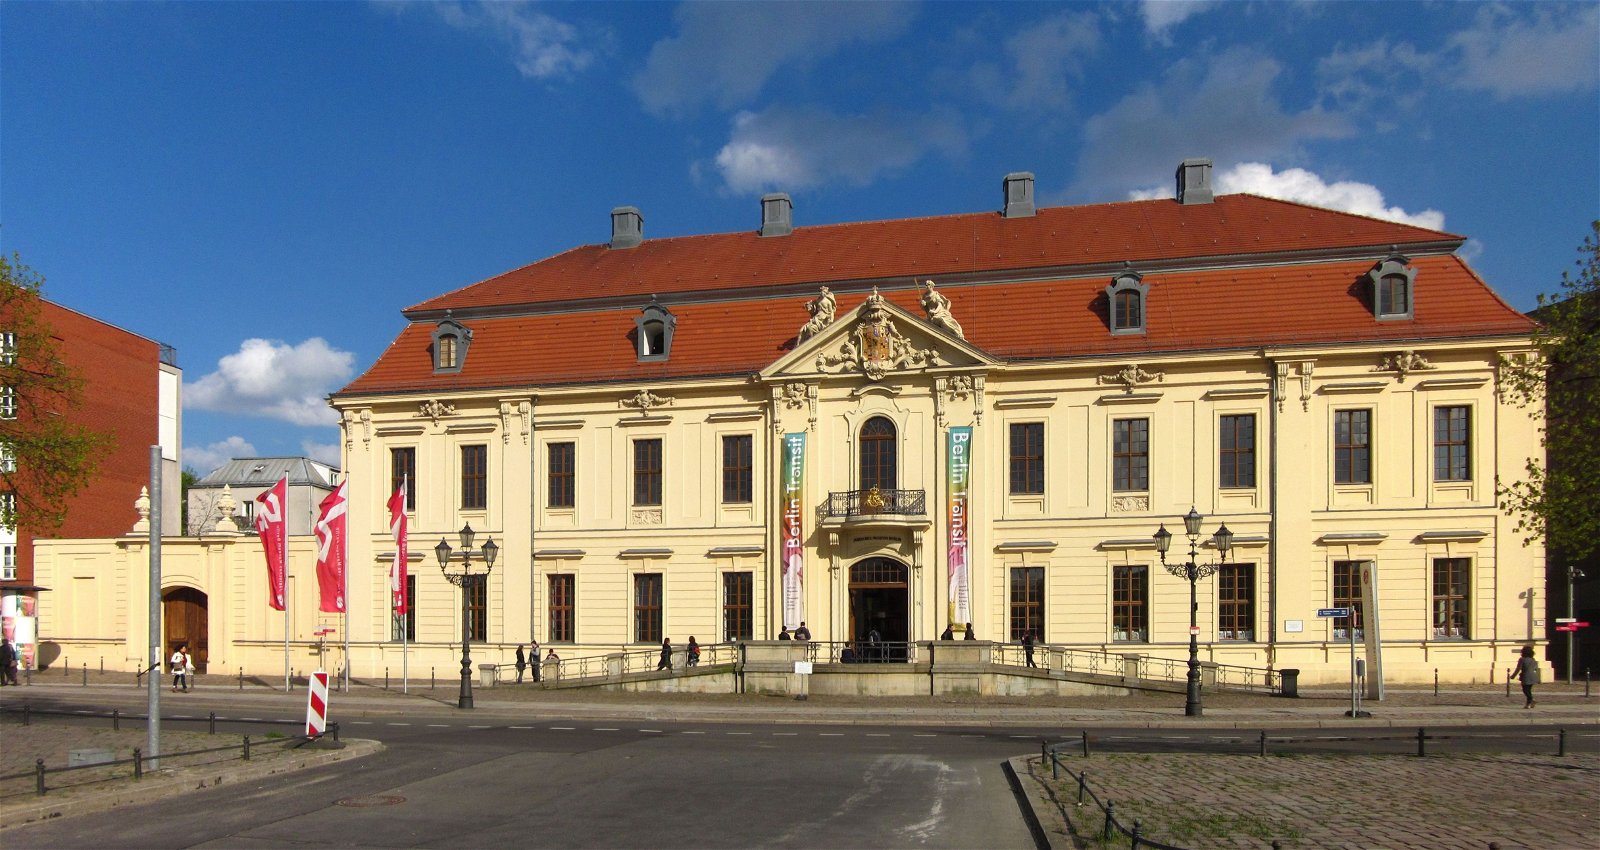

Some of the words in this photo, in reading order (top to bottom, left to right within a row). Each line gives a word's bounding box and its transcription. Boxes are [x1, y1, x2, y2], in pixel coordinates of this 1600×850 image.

[786, 436, 803, 494] Transit
[952, 432, 969, 484] Berlin
[785, 498, 800, 548] Berlin
[952, 488, 967, 547] Transit
